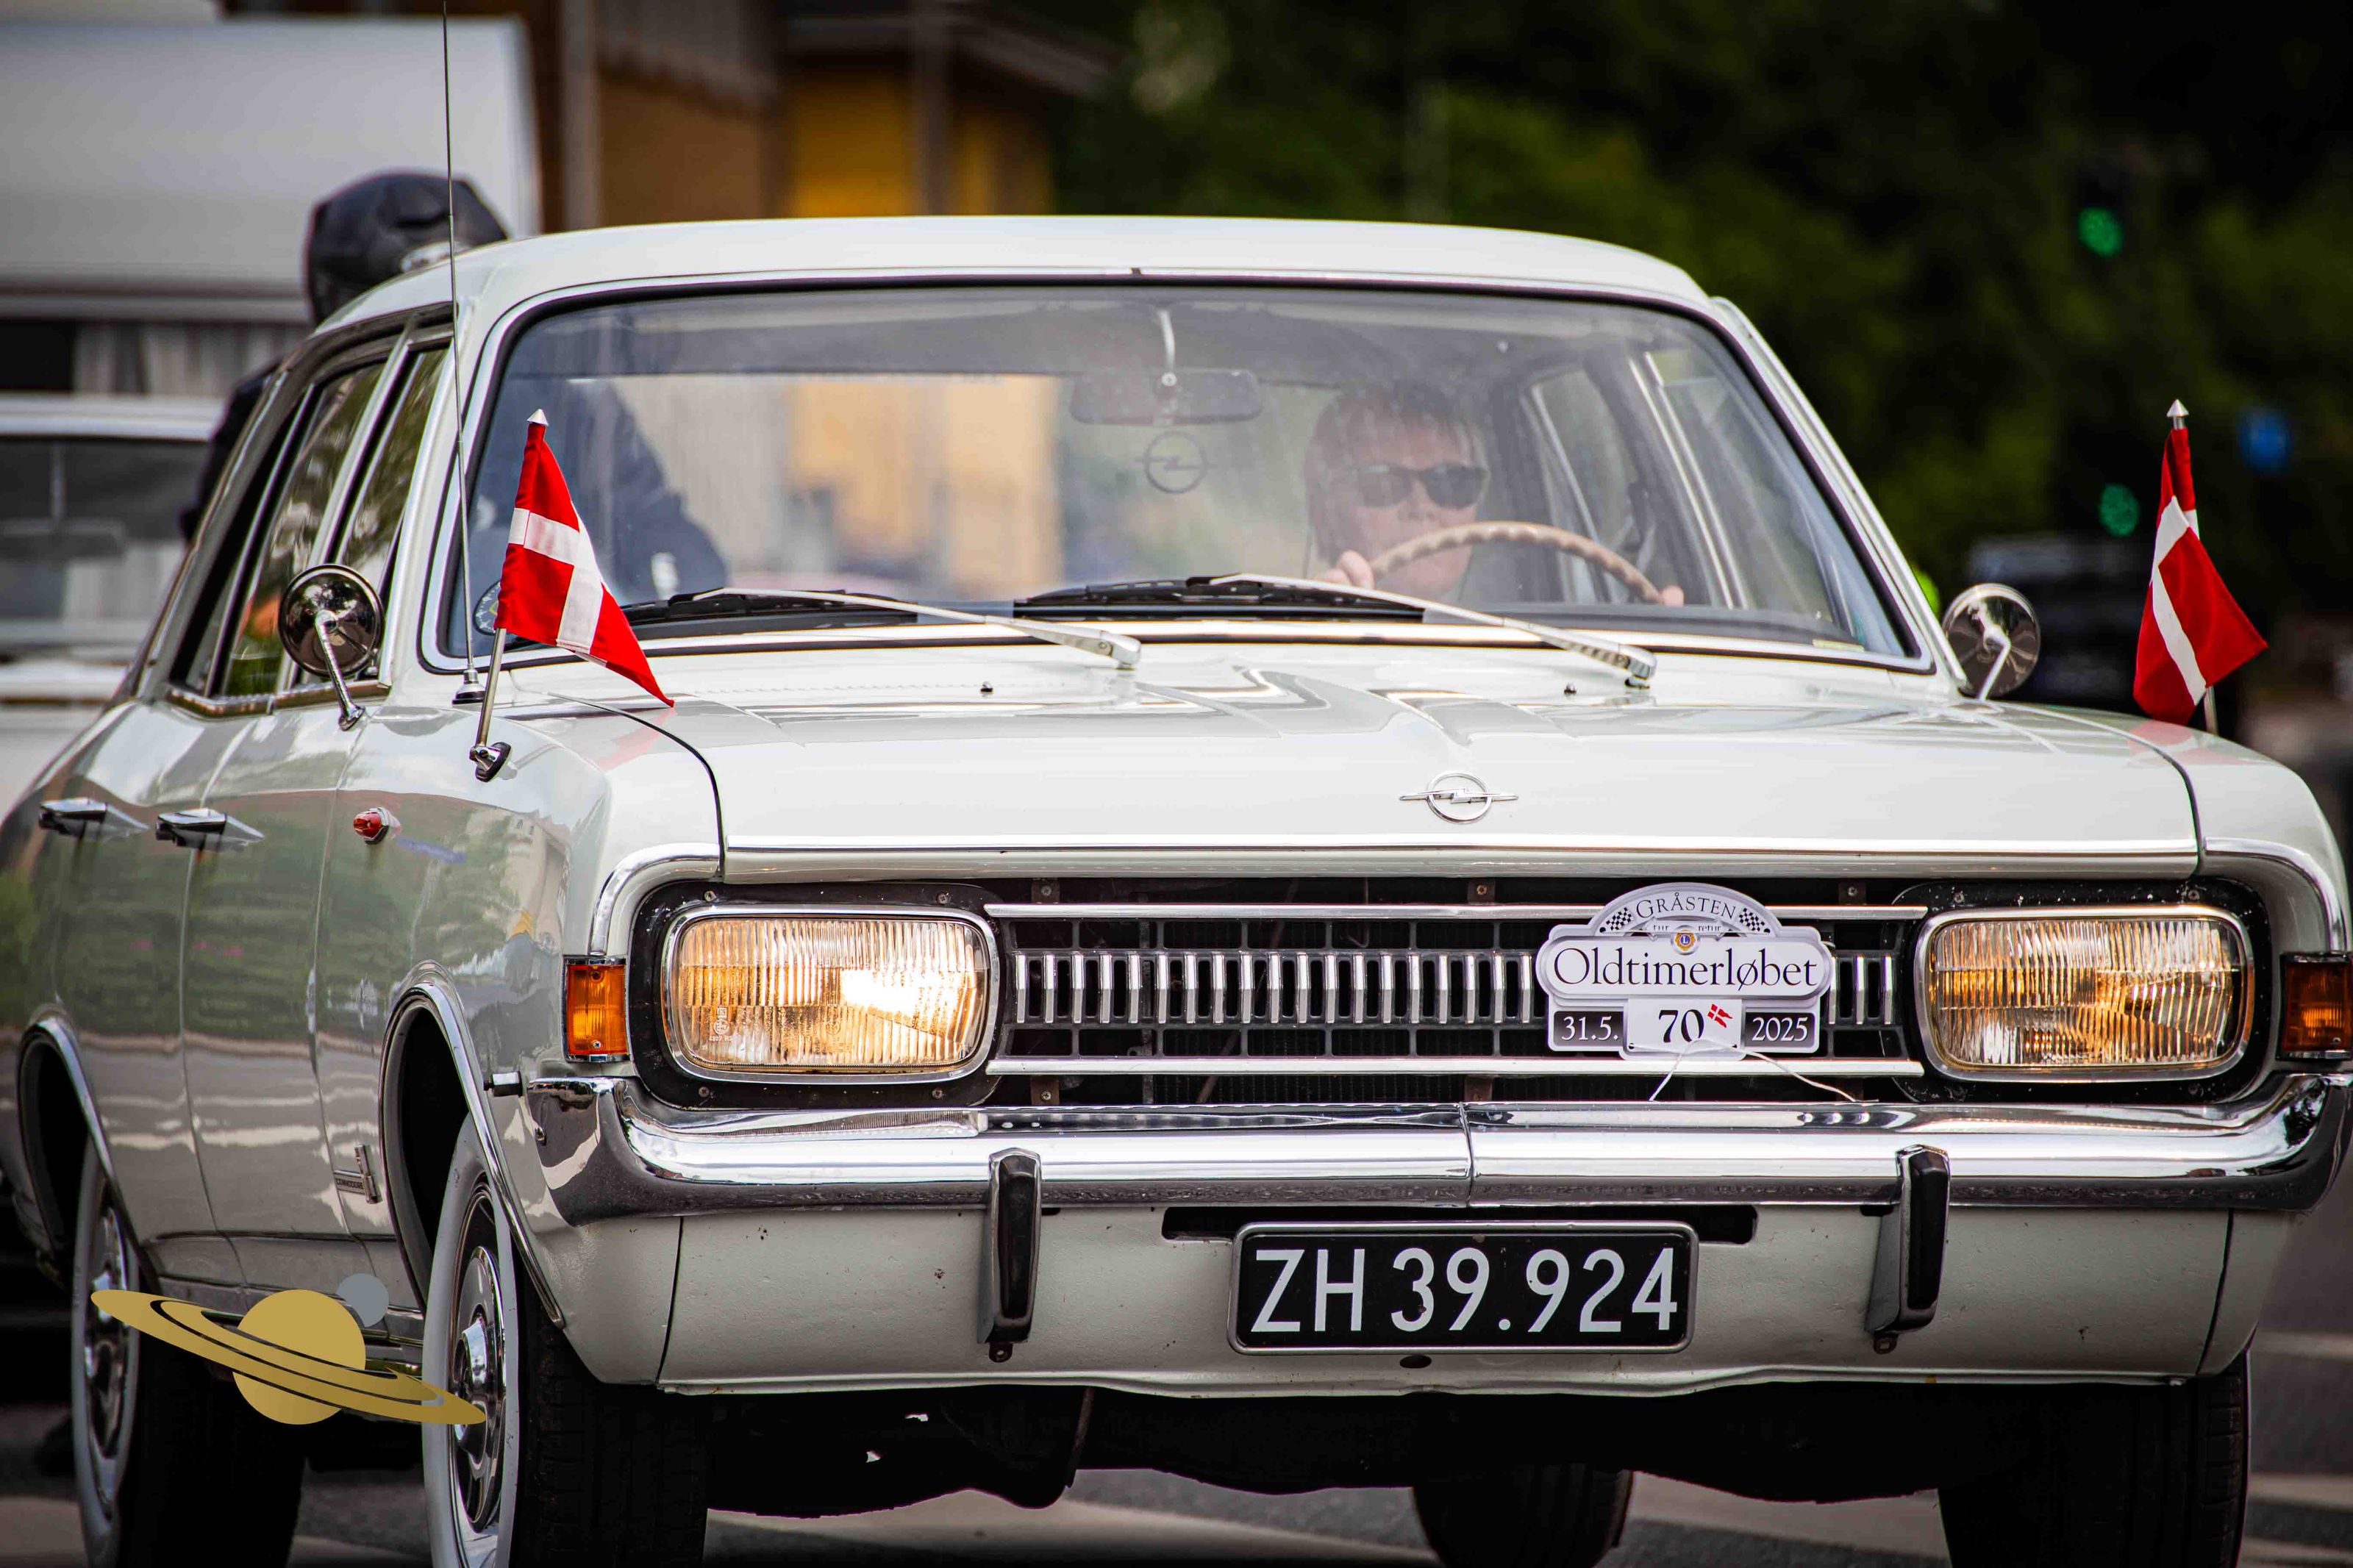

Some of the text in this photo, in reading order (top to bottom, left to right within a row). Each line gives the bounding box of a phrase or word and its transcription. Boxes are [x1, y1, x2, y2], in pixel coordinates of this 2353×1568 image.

[1636, 892, 1737, 919] GRÅSTEN
[1554, 946, 1818, 991] Oldtimerløbet
[1561, 1015, 1618, 1042] 31.5.
[1658, 1009, 1705, 1043] 70
[1752, 1017, 1809, 1042] 2025
[1250, 1247, 1678, 1332] ZH 39.924
